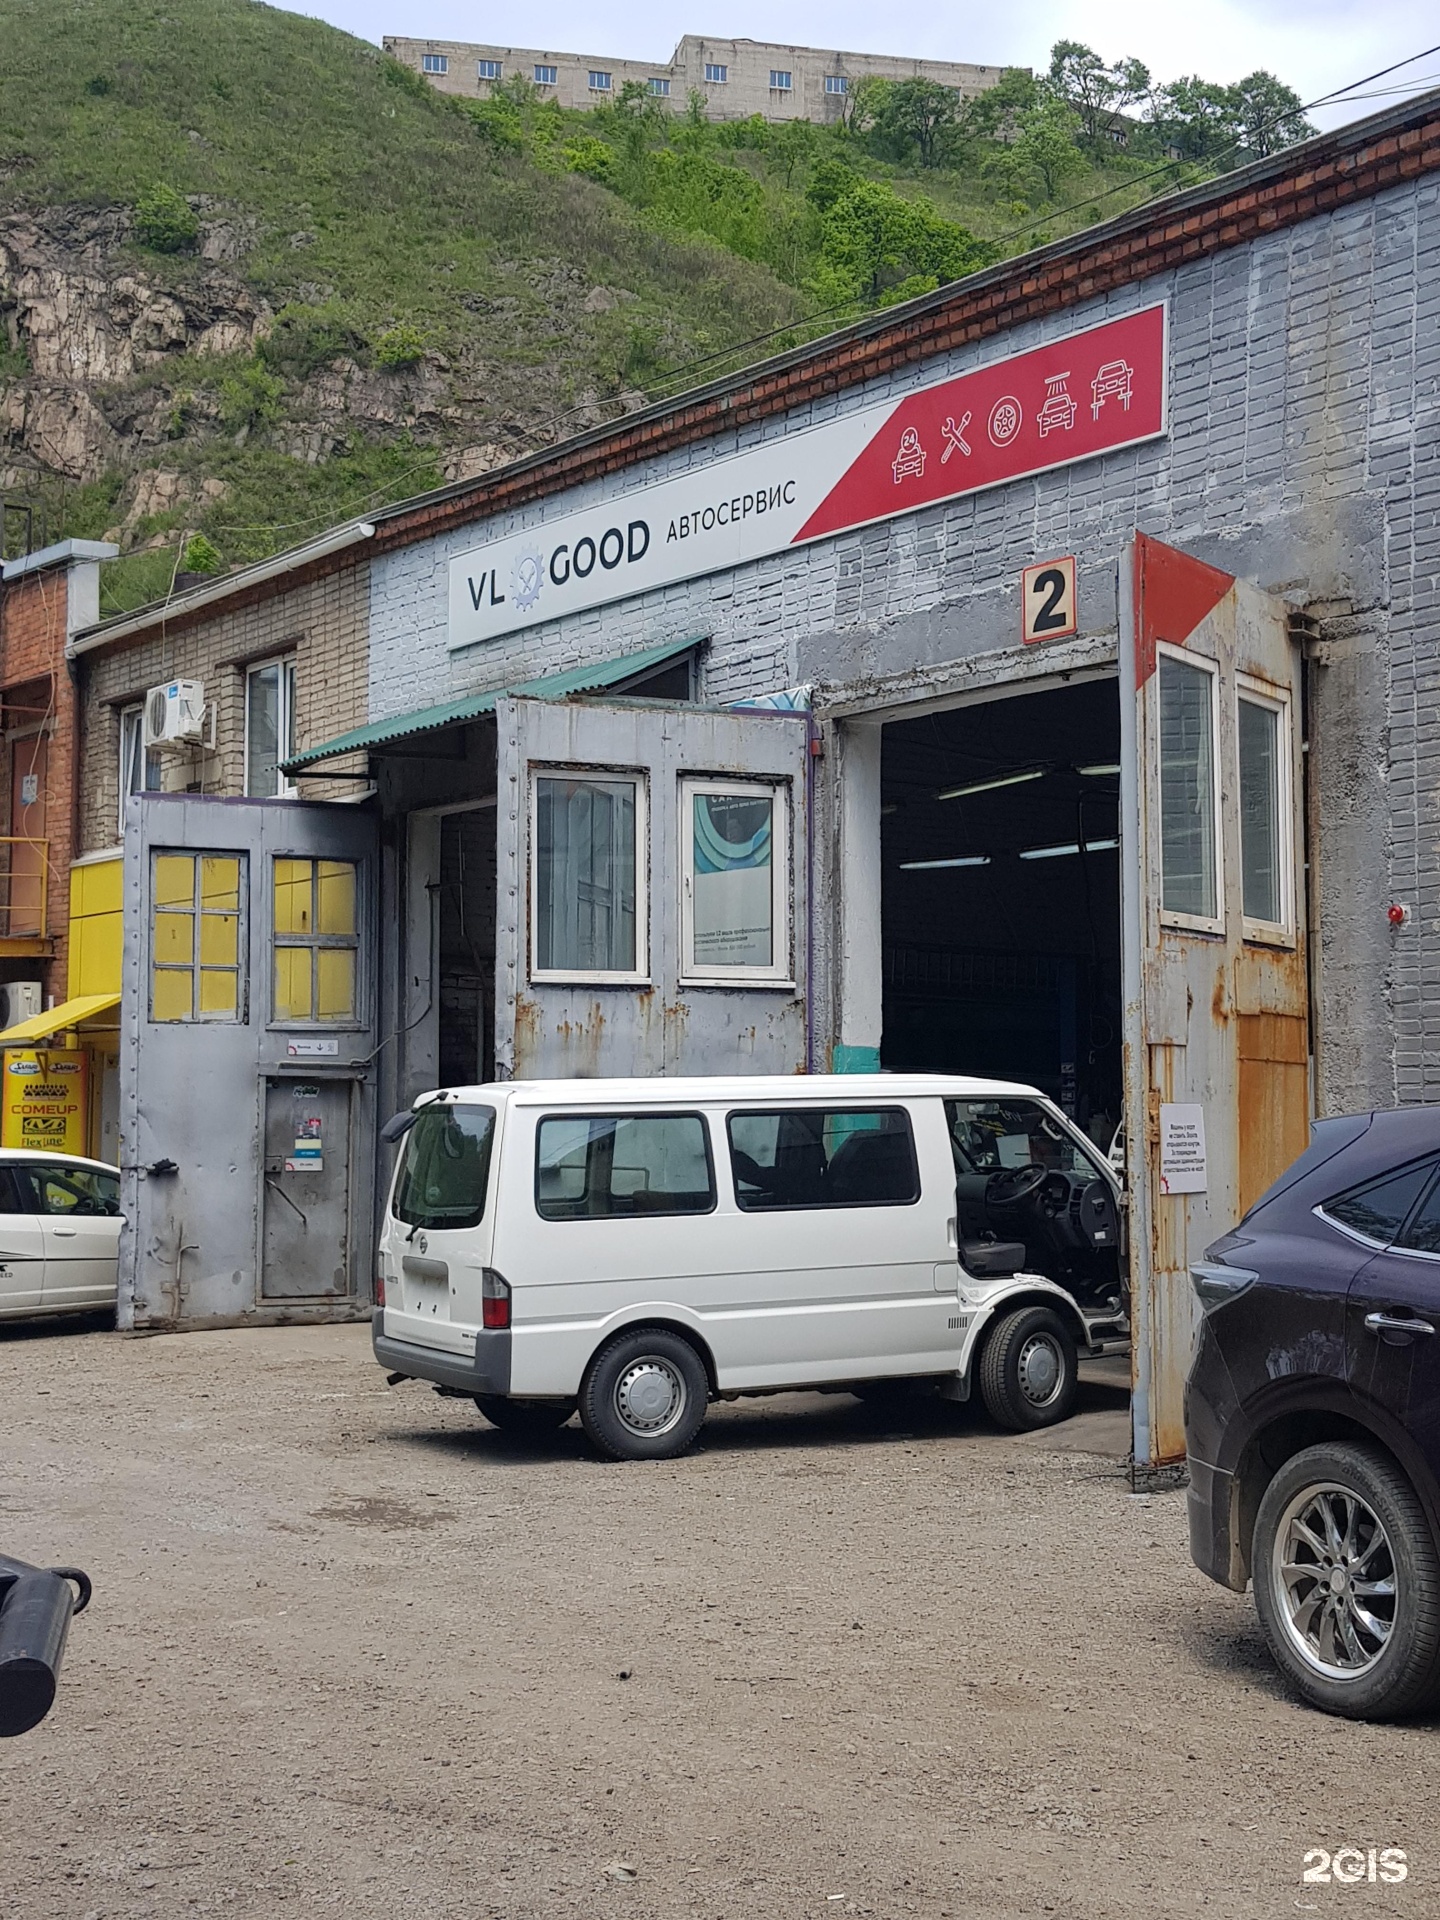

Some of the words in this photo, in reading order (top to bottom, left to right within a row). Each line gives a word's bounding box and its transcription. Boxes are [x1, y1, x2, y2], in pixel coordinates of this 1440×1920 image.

[903, 433, 915, 447] 24
[467, 568, 506, 612] VL
[549, 519, 651, 586] GOOD
[666, 480, 796, 544] АВТОСЕРВИС
[1032, 569, 1067, 633] 2
[11, 1104, 78, 1115] COMEUP
